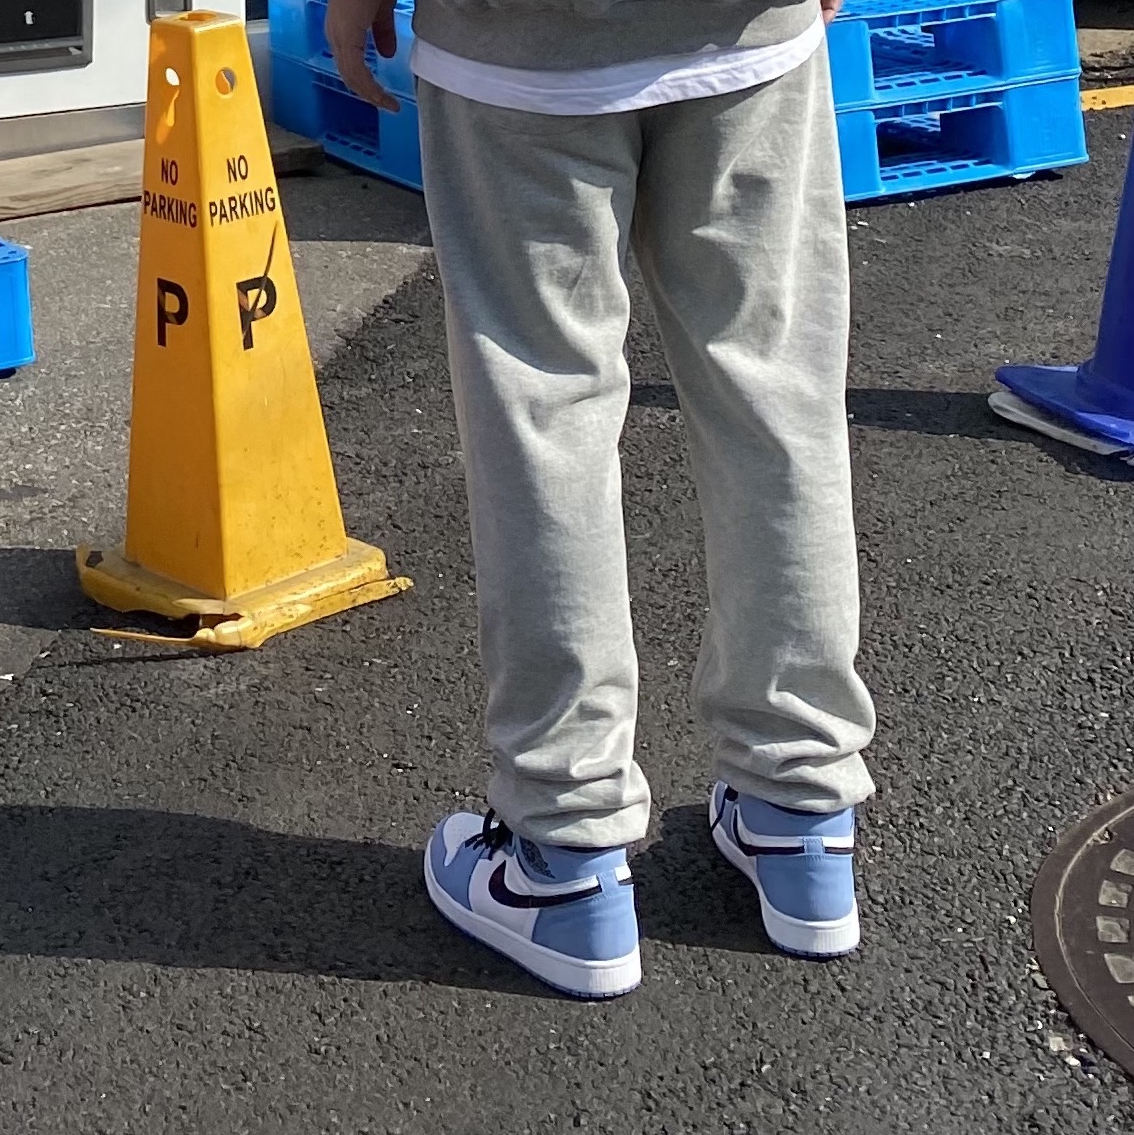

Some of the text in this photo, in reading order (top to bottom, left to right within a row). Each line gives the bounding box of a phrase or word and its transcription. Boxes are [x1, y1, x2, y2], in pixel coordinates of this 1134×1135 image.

[160, 156, 179, 186] NO
[226, 154, 249, 184] NO
[143, 189, 198, 229] PARKING
[208, 186, 277, 228] PARKING
[157, 277, 189, 348] P
[235, 275, 278, 351] P
